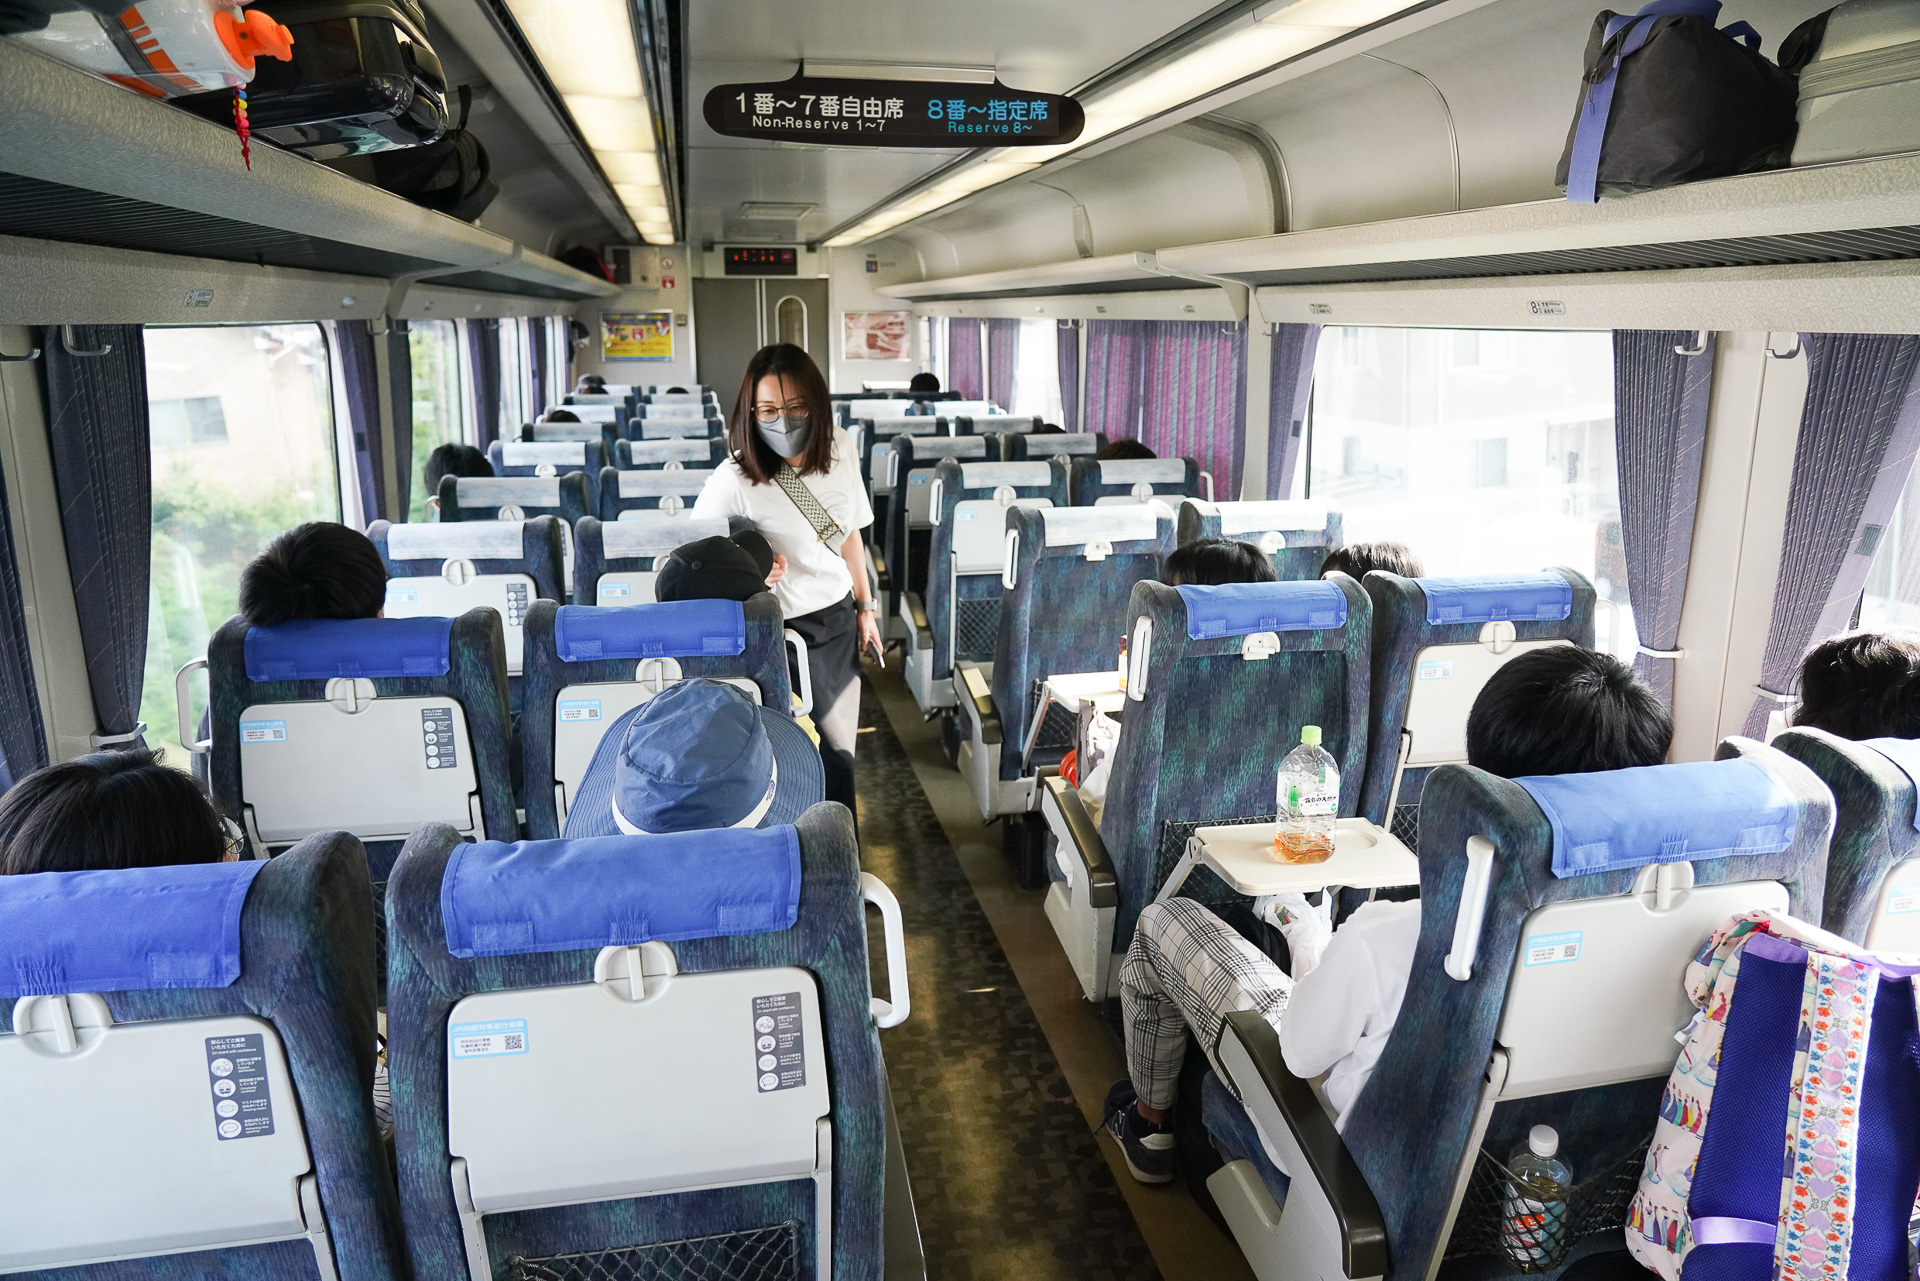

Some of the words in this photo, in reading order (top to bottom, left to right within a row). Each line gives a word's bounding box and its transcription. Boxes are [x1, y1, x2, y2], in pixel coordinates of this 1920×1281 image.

[752, 114, 849, 131] Non-Reserve
[948, 121, 1009, 134] Reserve
[1530, 301, 1538, 314] 8
